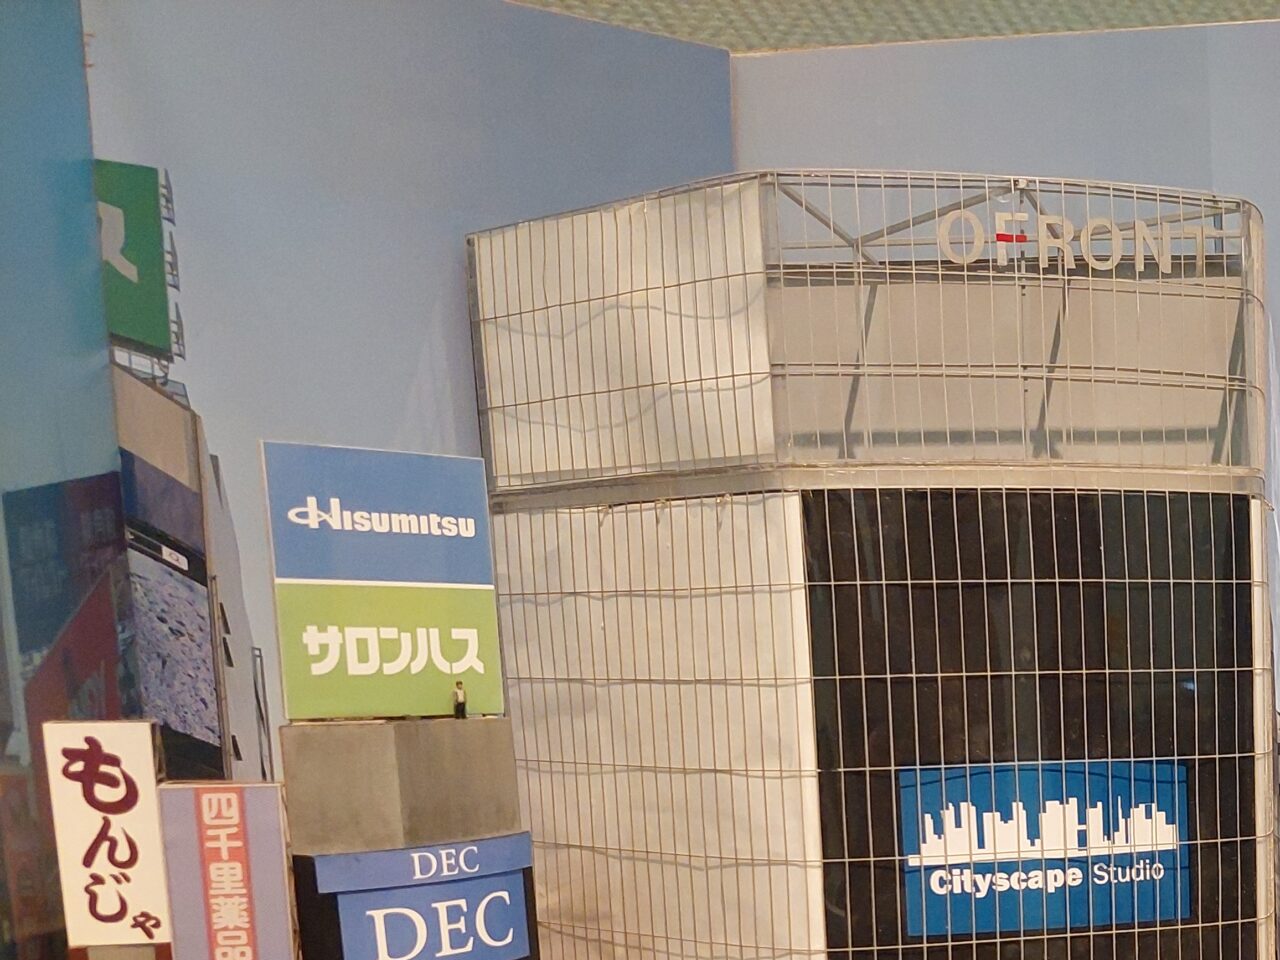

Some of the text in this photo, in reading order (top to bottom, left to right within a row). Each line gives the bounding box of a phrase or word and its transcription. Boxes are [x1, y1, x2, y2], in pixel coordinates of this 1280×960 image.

[302, 625, 485, 676] サロンハス
[61, 736, 161, 940] もんじゃ
[411, 846, 480, 879] DEC
[930, 859, 1165, 898] Cityscape Studio
